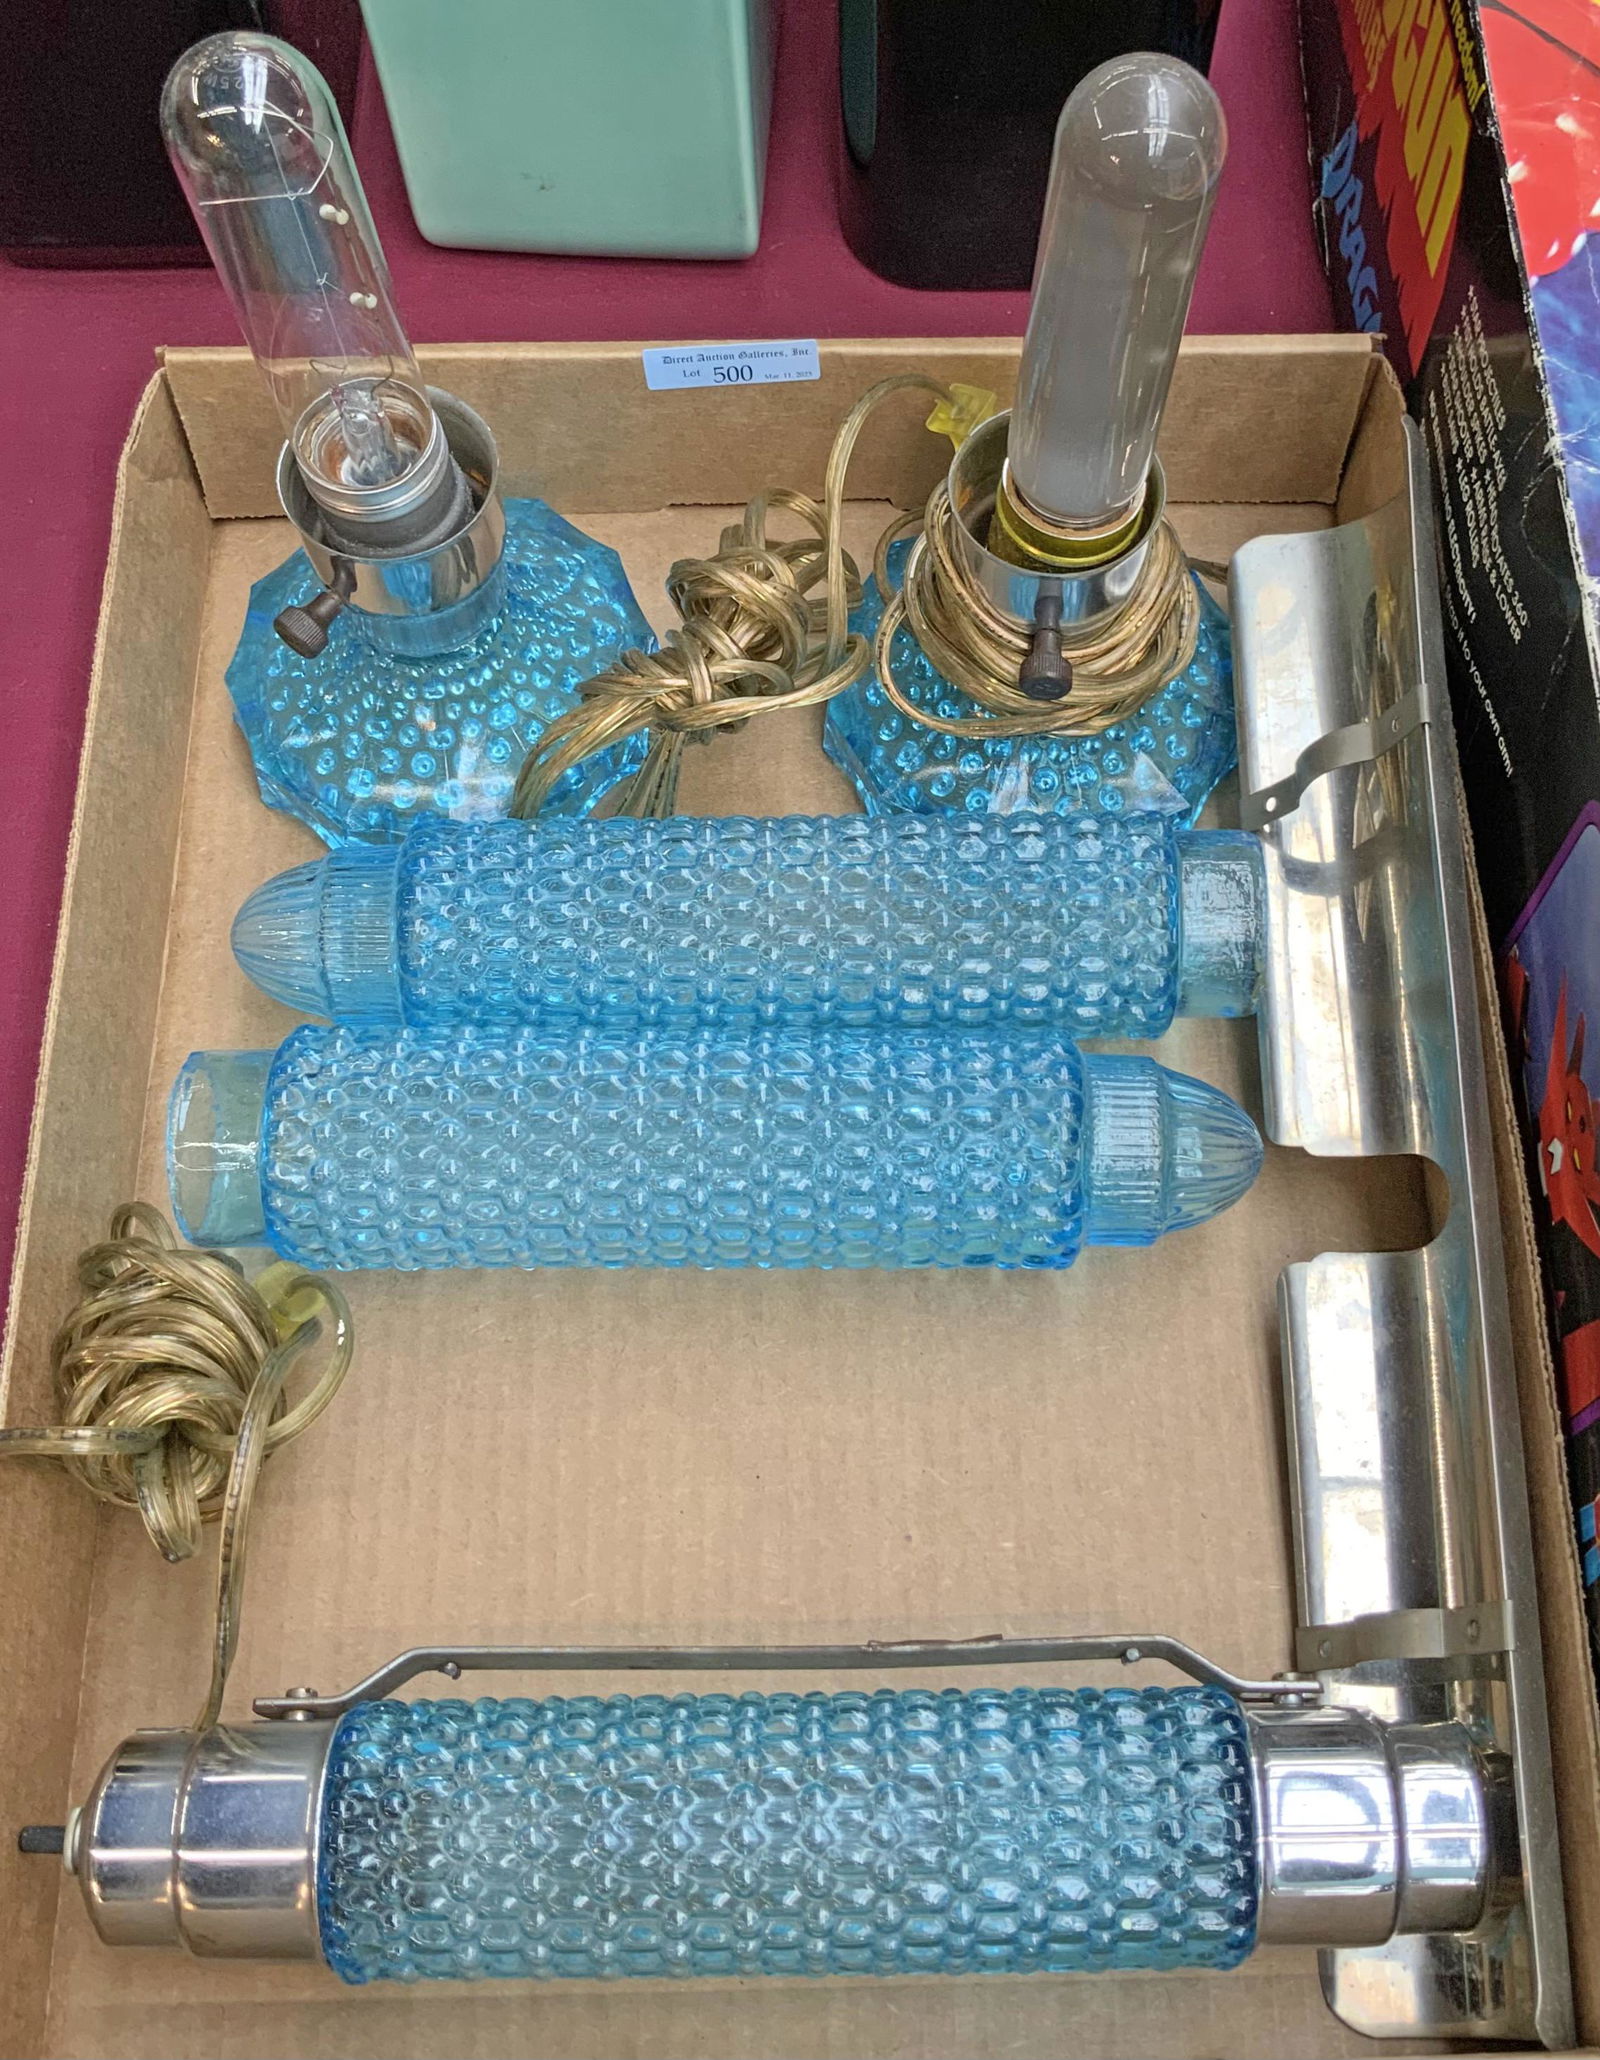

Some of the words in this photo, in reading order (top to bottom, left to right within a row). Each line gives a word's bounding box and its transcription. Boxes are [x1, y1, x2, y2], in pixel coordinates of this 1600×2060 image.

[662, 355, 693, 365] Direct
[696, 353, 735, 363] Auction
[738, 348, 788, 360] Galleries,
[682, 370, 701, 378] Lot
[713, 364, 753, 383] 500
[1467, 344, 1484, 400] HOLDS
[1469, 413, 1488, 464] SPIKES
[1457, 470, 1471, 502] LEG
[1465, 500, 1480, 568] ROLLERS
[1486, 482, 1499, 526] HEAD
[1473, 480, 1490, 527] ARMS
[1495, 584, 1522, 645] LOWER
[1490, 525, 1514, 593] ROTATES
[1460, 640, 1472, 660] to
[1468, 660, 1488, 698] your
[1484, 698, 1501, 736] own
[1498, 736, 1514, 778] arm!
